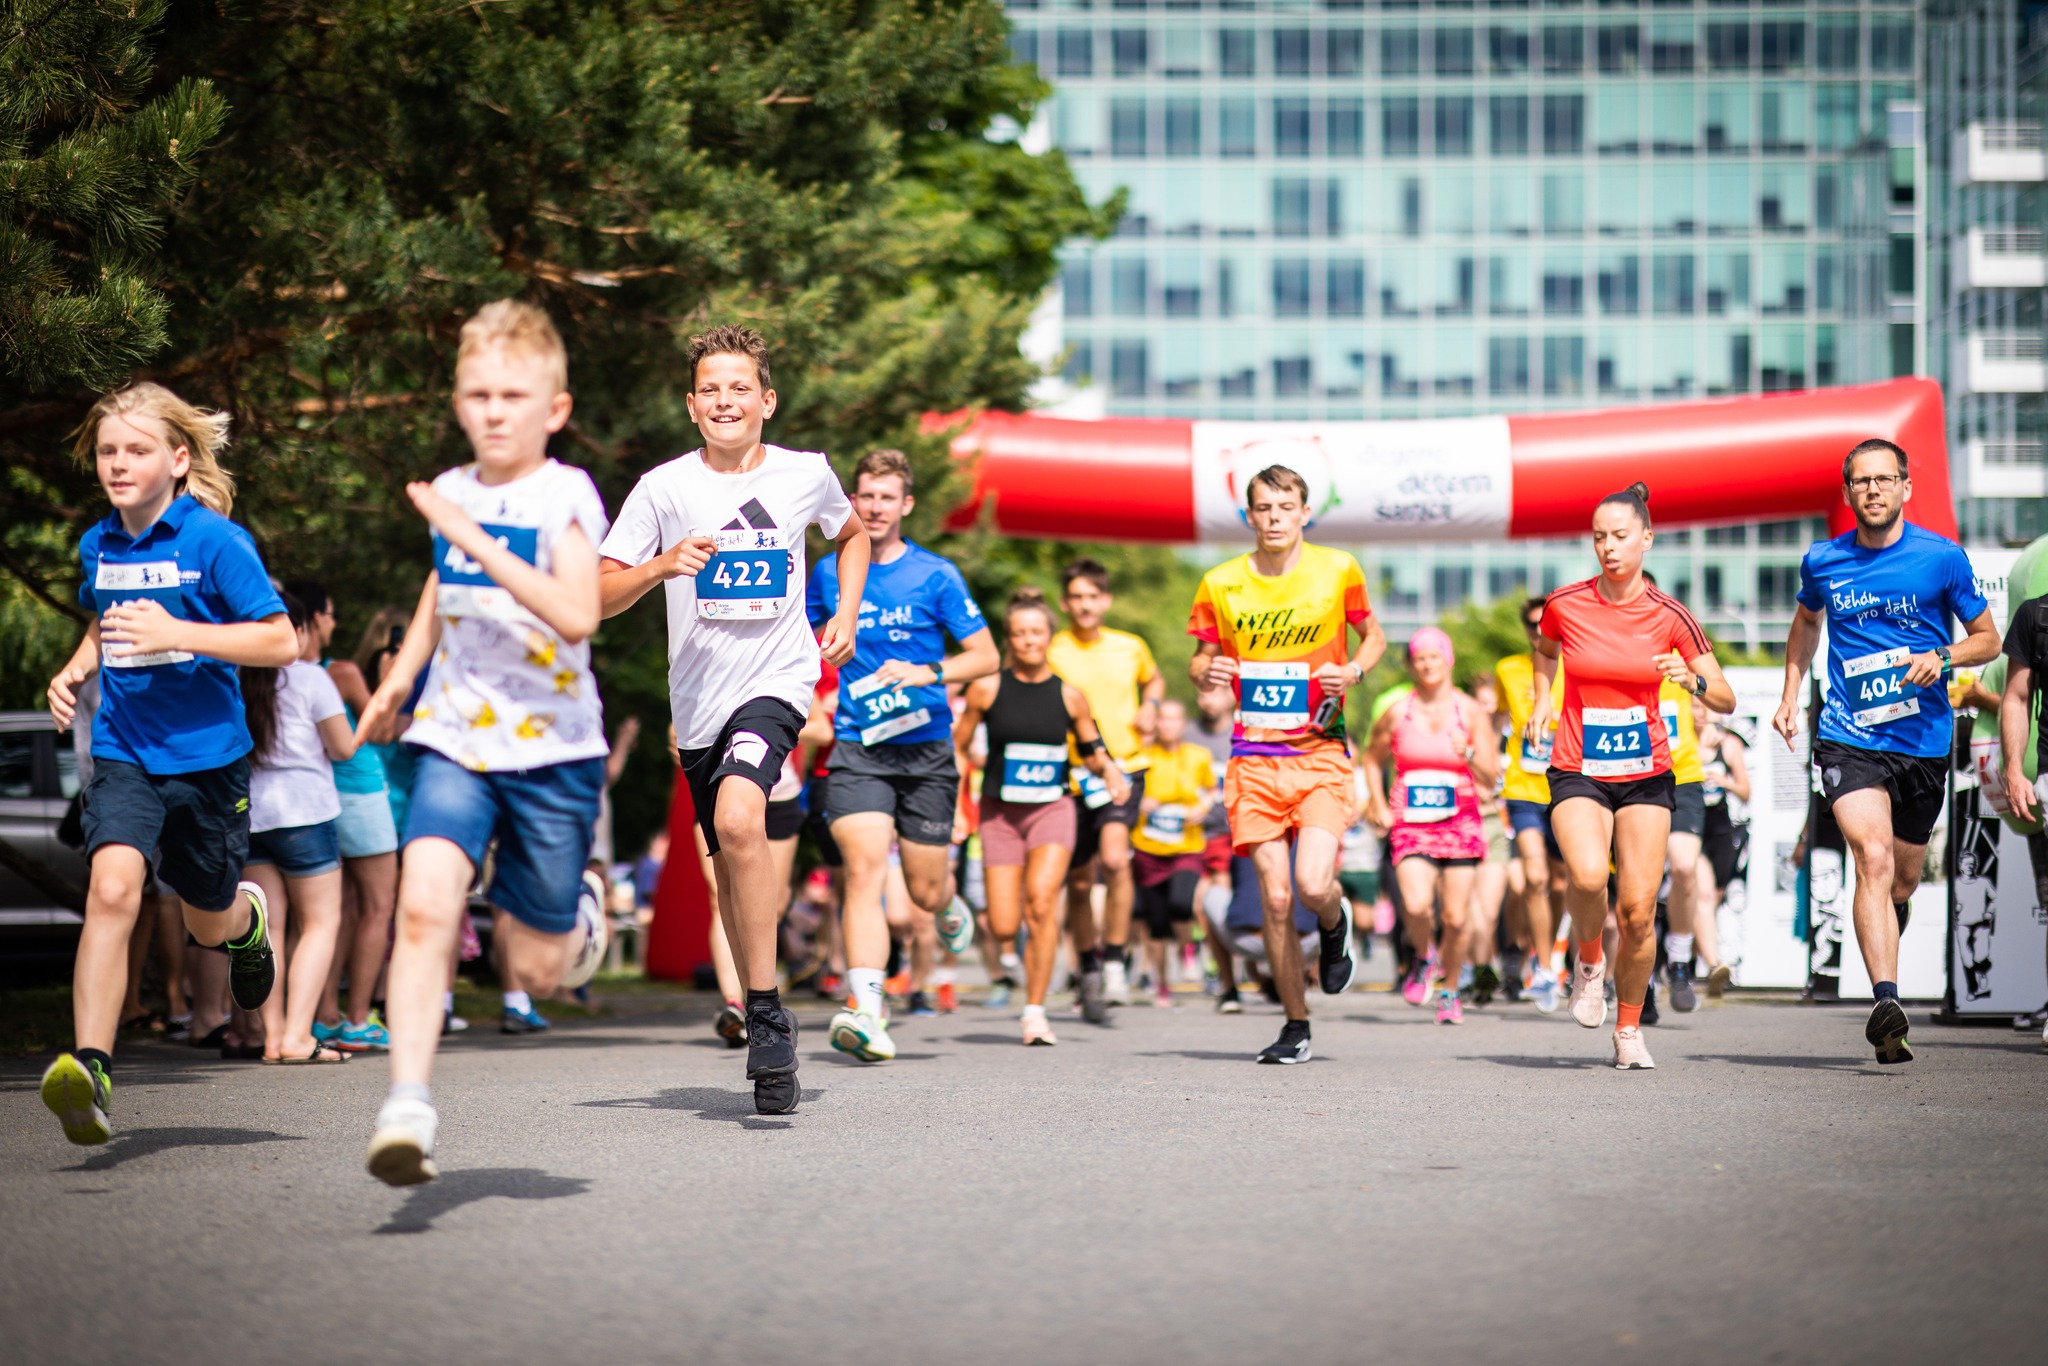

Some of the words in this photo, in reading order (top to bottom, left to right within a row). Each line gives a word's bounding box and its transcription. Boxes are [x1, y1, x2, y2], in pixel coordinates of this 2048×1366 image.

[712, 560, 772, 589] 422
[1832, 589, 1881, 611] Běhám
[1856, 609, 1878, 627] pro
[1885, 594, 1919, 616] děti!
[1249, 633, 1264, 651] V
[1252, 685, 1296, 707] 437
[1859, 674, 1903, 702] 404
[864, 690, 911, 721] 304
[1595, 730, 1641, 754] 412
[1015, 764, 1055, 783] 440
